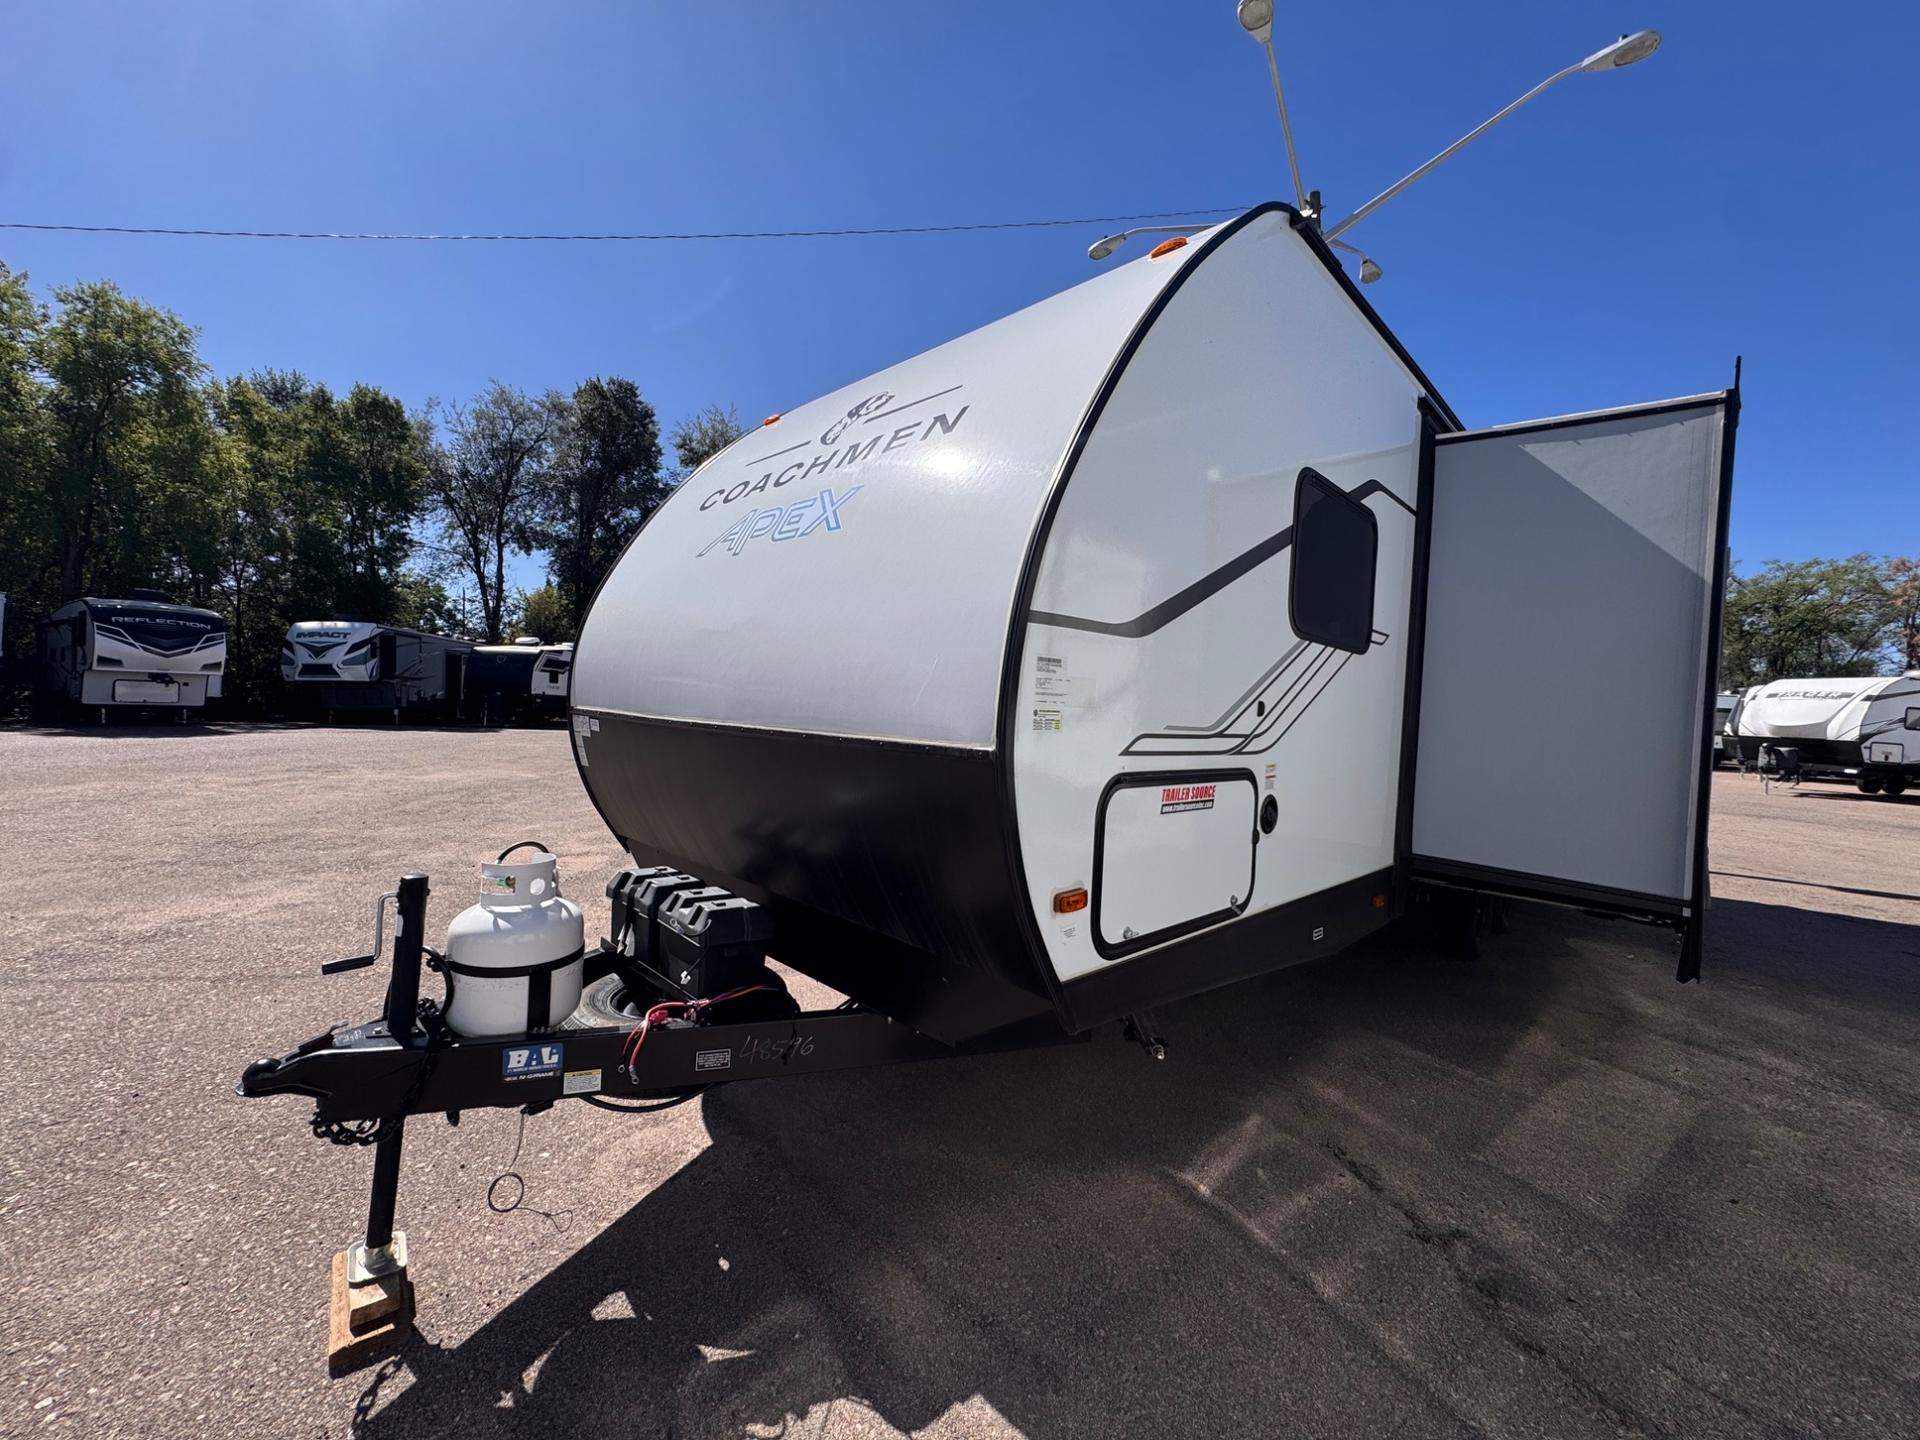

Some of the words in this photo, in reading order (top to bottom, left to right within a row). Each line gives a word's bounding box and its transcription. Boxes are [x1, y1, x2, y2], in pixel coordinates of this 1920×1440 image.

[699, 405, 970, 511] COACHMEN
[695, 483, 865, 558] APEX
[111, 616, 212, 630] REFLECTION
[296, 631, 352, 639] IMPACT
[1161, 787, 1190, 802] TRAILER
[1191, 784, 1216, 799] SOURCE
